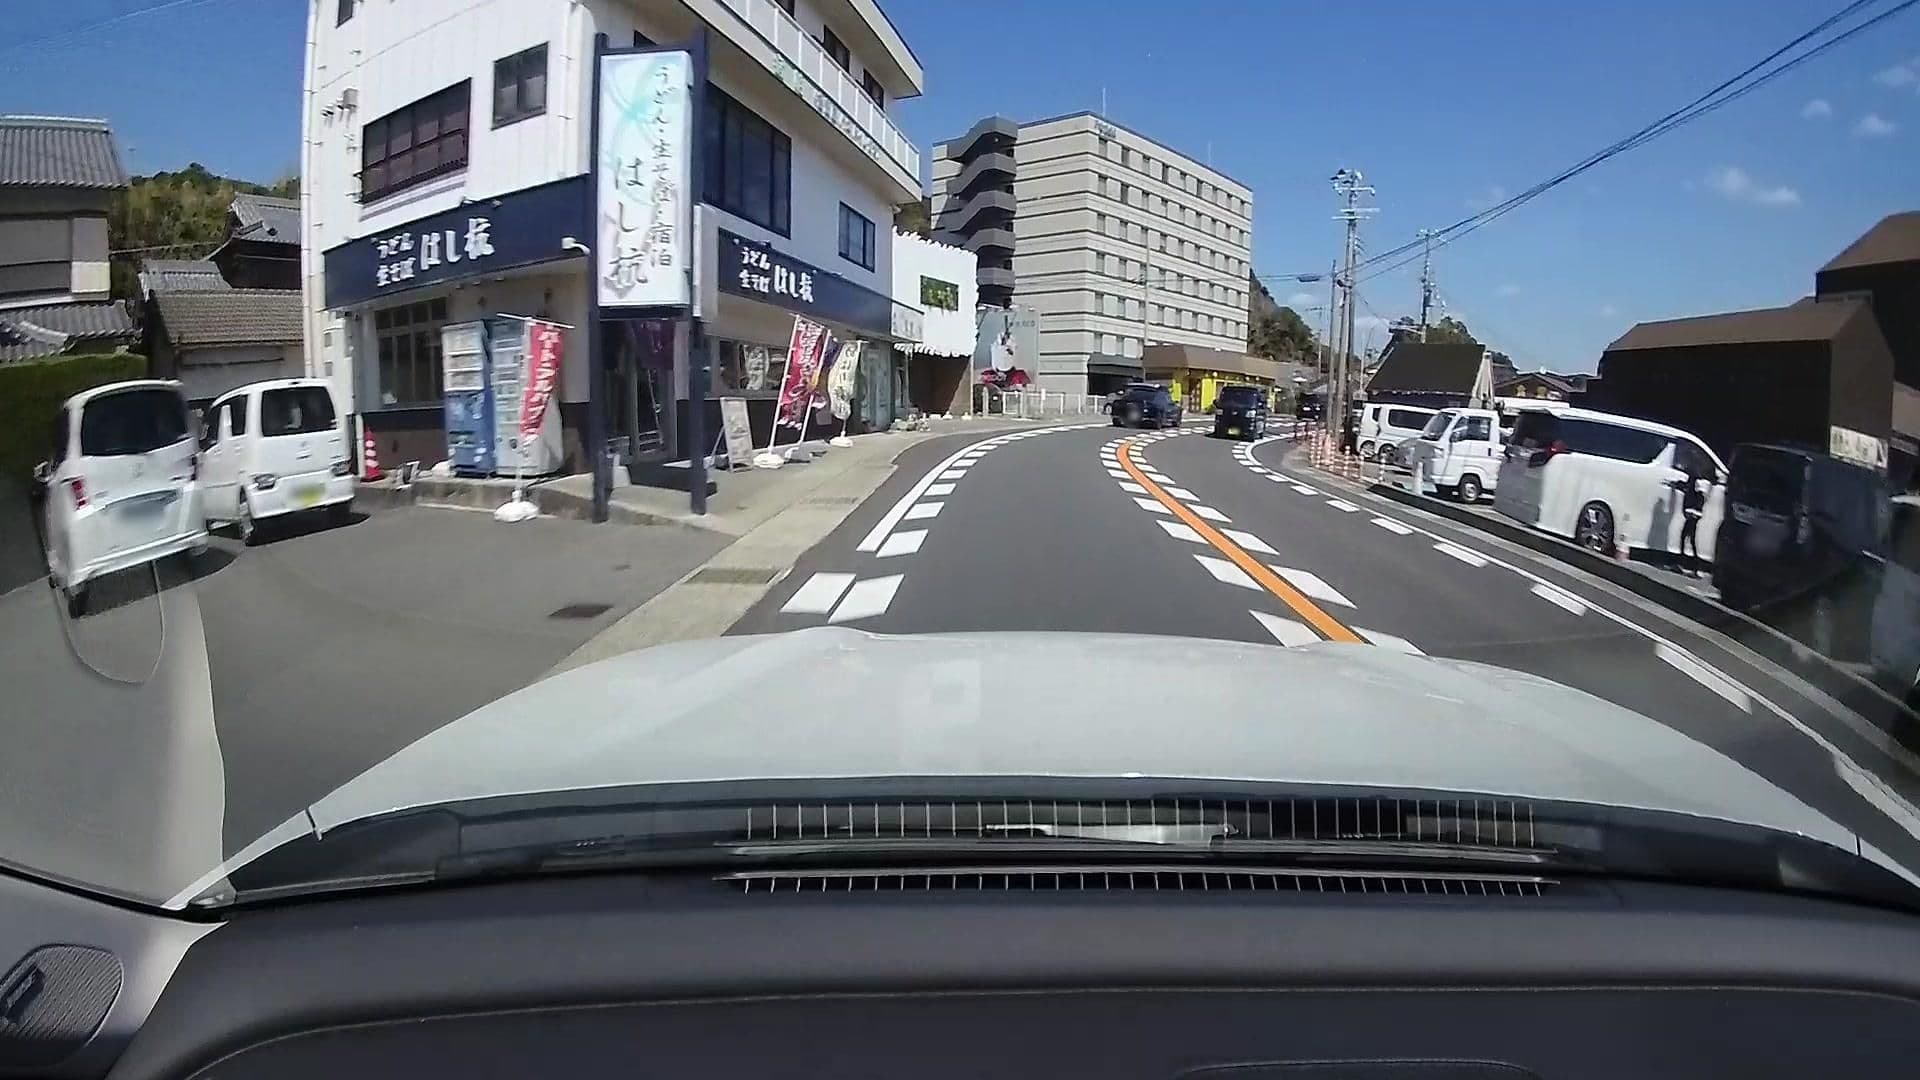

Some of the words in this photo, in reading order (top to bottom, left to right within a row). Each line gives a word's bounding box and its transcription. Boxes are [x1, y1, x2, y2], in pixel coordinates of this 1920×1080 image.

[377, 233, 415, 259] うどん
[741, 246, 771, 271] うどん
[377, 257, 417, 287] 生そば
[739, 269, 771, 294] 生そば
